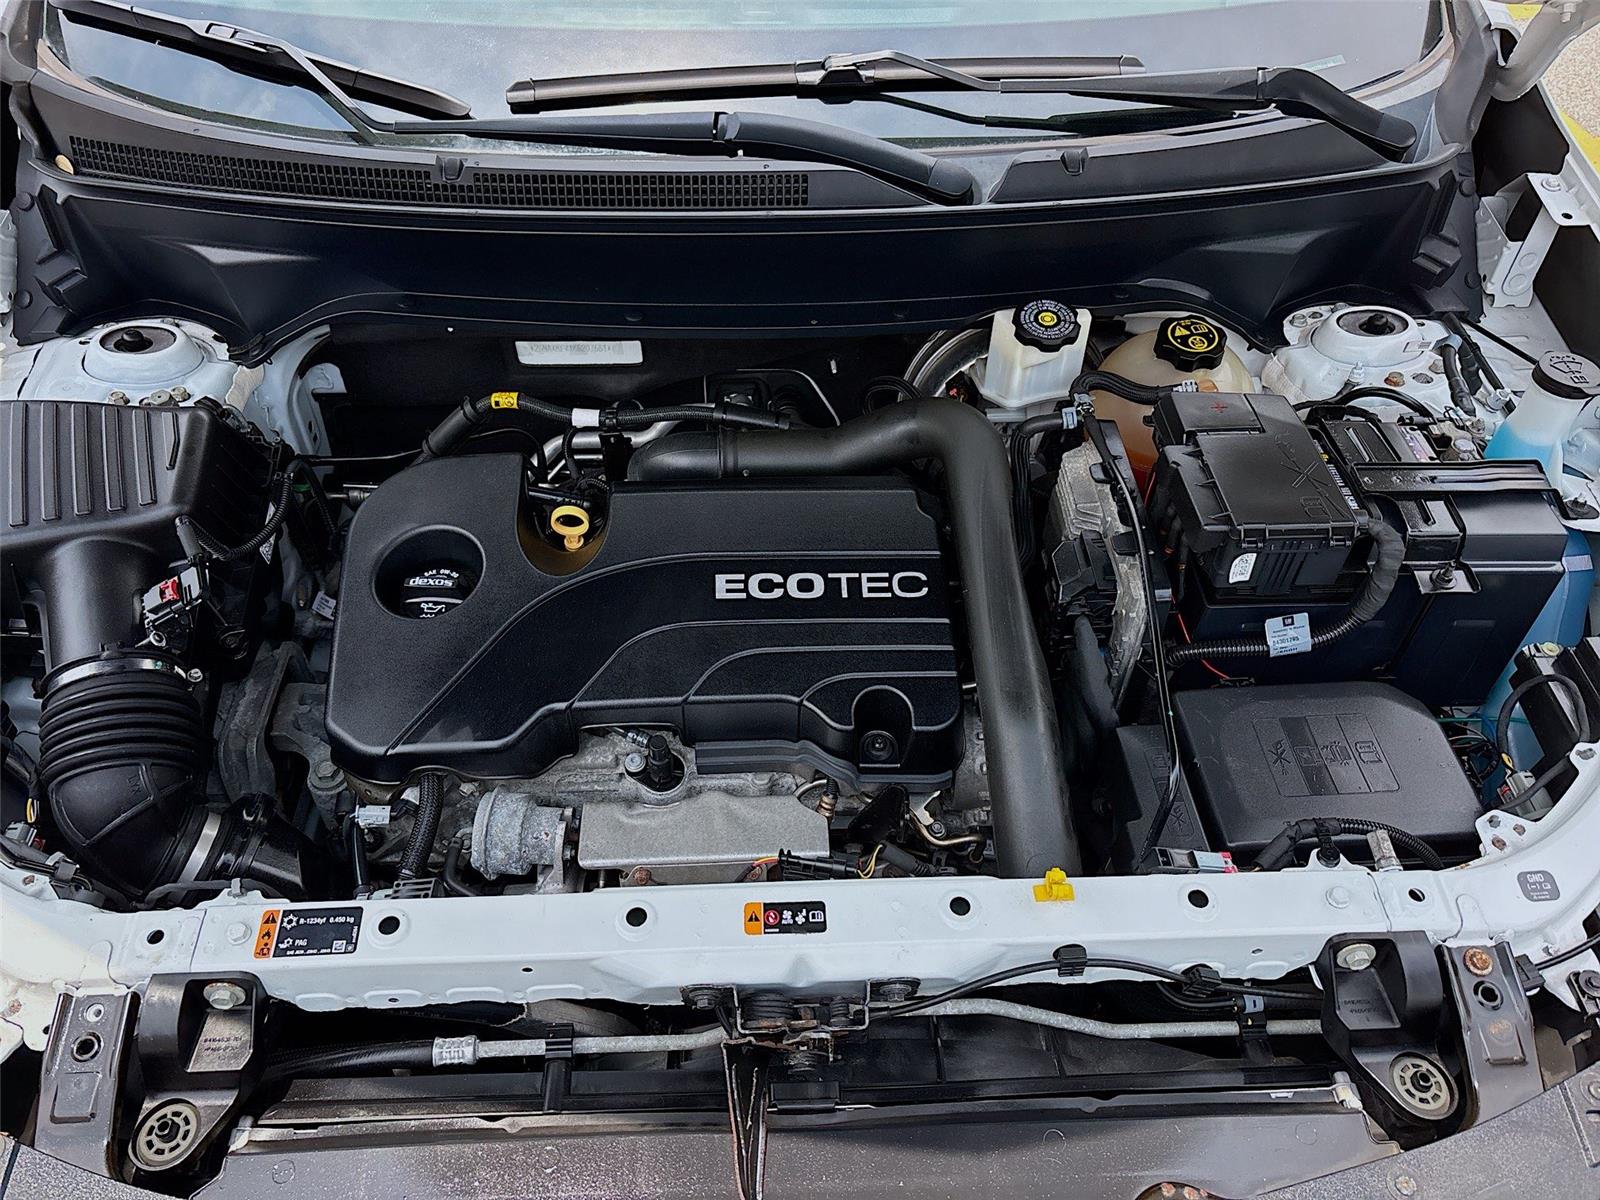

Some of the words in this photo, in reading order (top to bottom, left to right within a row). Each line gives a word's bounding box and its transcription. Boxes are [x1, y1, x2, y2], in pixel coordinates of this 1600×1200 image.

[409, 577, 453, 587] dexos
[715, 571, 929, 599] ECOTEC
[1527, 873, 1545, 882] GND
[294, 939, 308, 947] PAG
